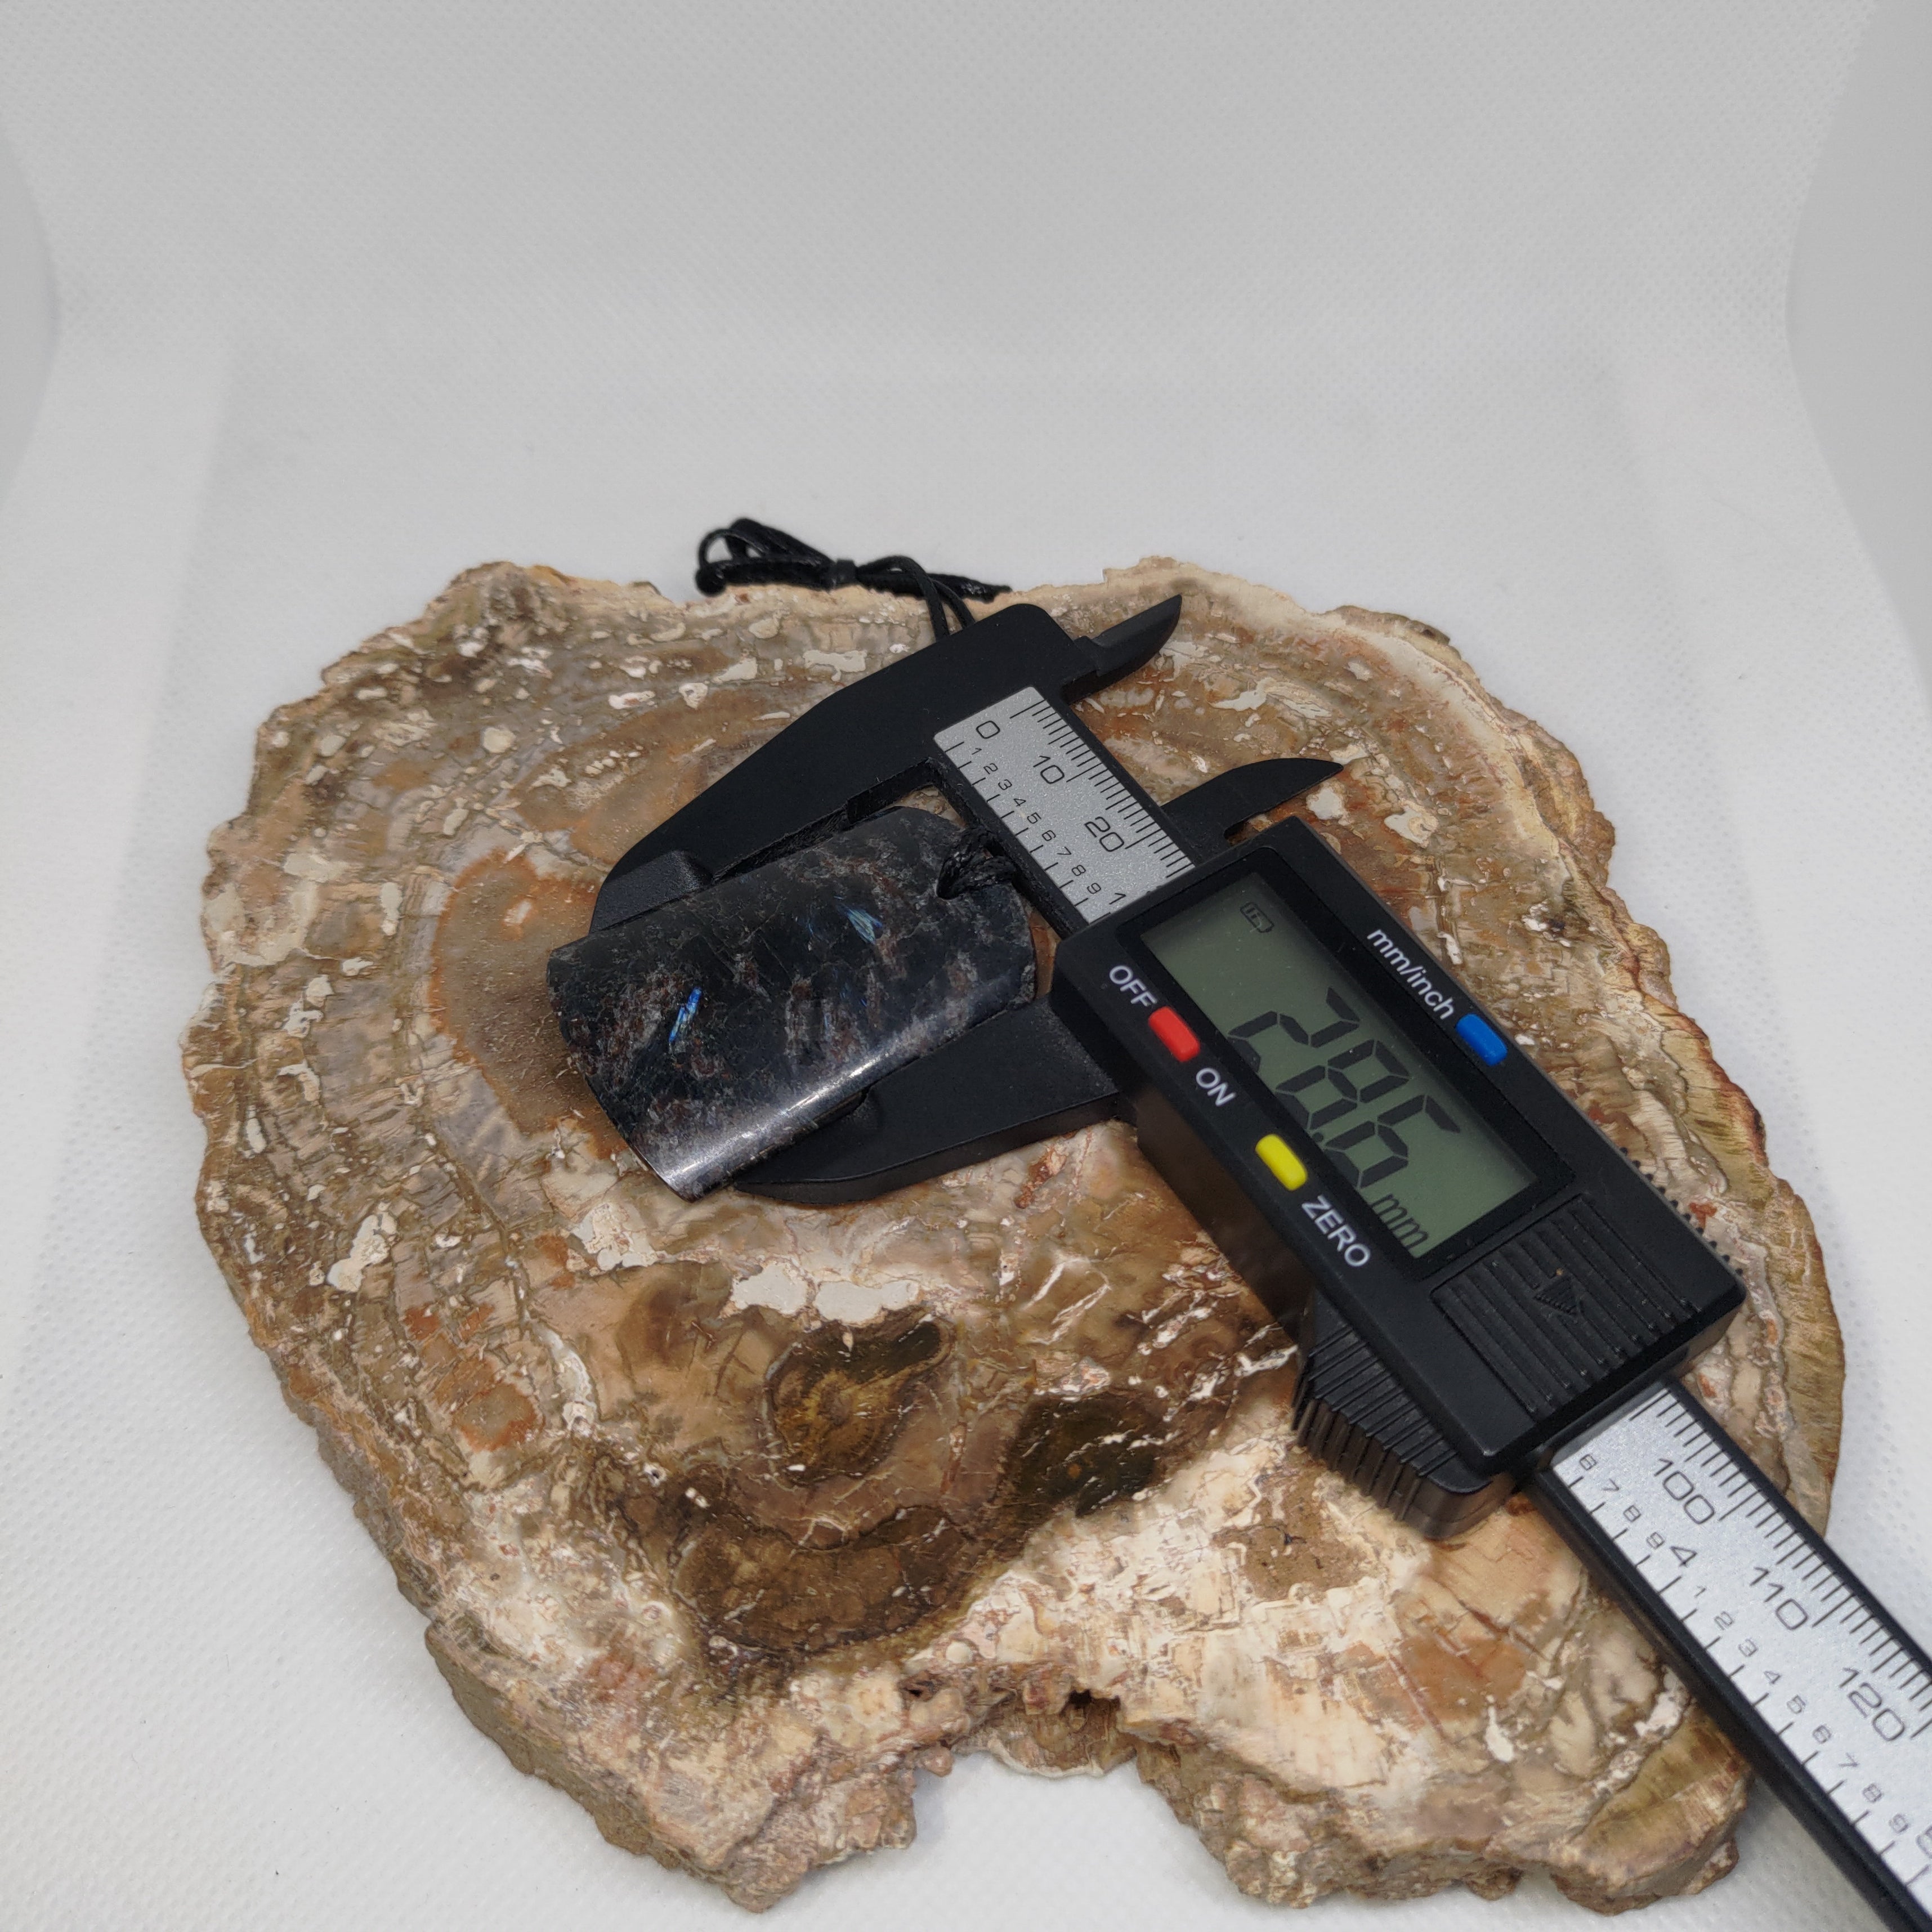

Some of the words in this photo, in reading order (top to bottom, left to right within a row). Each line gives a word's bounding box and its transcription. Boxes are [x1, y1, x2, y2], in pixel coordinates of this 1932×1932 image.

[976, 721, 1000, 739] 0
[1033, 755, 1065, 784] 10
[1084, 816, 1124, 852] 20
[983, 763, 998, 774] 2
[998, 779, 1012, 790] 3
[1014, 798, 1026, 807] 4
[1027, 812, 1041, 824] 5
[1041, 830, 1056, 842] 6
[1057, 847, 1072, 857] 7
[1071, 865, 1086, 876] 8
[1087, 883, 1102, 894] 9
[1109, 892, 1126, 905] 1
[1108, 965, 1157, 1009] OFF
[1366, 928, 1456, 1019] mm/inch
[1195, 1067, 1236, 1107] ON
[1301, 1194, 1371, 1268] ZERO
[1371, 1193, 1428, 1250] mm
[1603, 1478, 1620, 1493] 7
[1622, 1505, 1641, 1522] 8
[1670, 1544, 1697, 1567] 4
[1694, 1586, 1707, 1597] 1
[1714, 1611, 1734, 1631] 2
[1738, 1639, 1757, 1657] 3
[1764, 1670, 1782, 1684] 4
[1786, 1695, 1806, 1714] 5
[1812, 1725, 1832, 1743] 6
[1839, 1752, 1858, 1768] 7
[1654, 1457, 1715, 1524] 100
[1750, 1566, 1808, 1630] 110
[1839, 1666, 1906, 1741] 120
